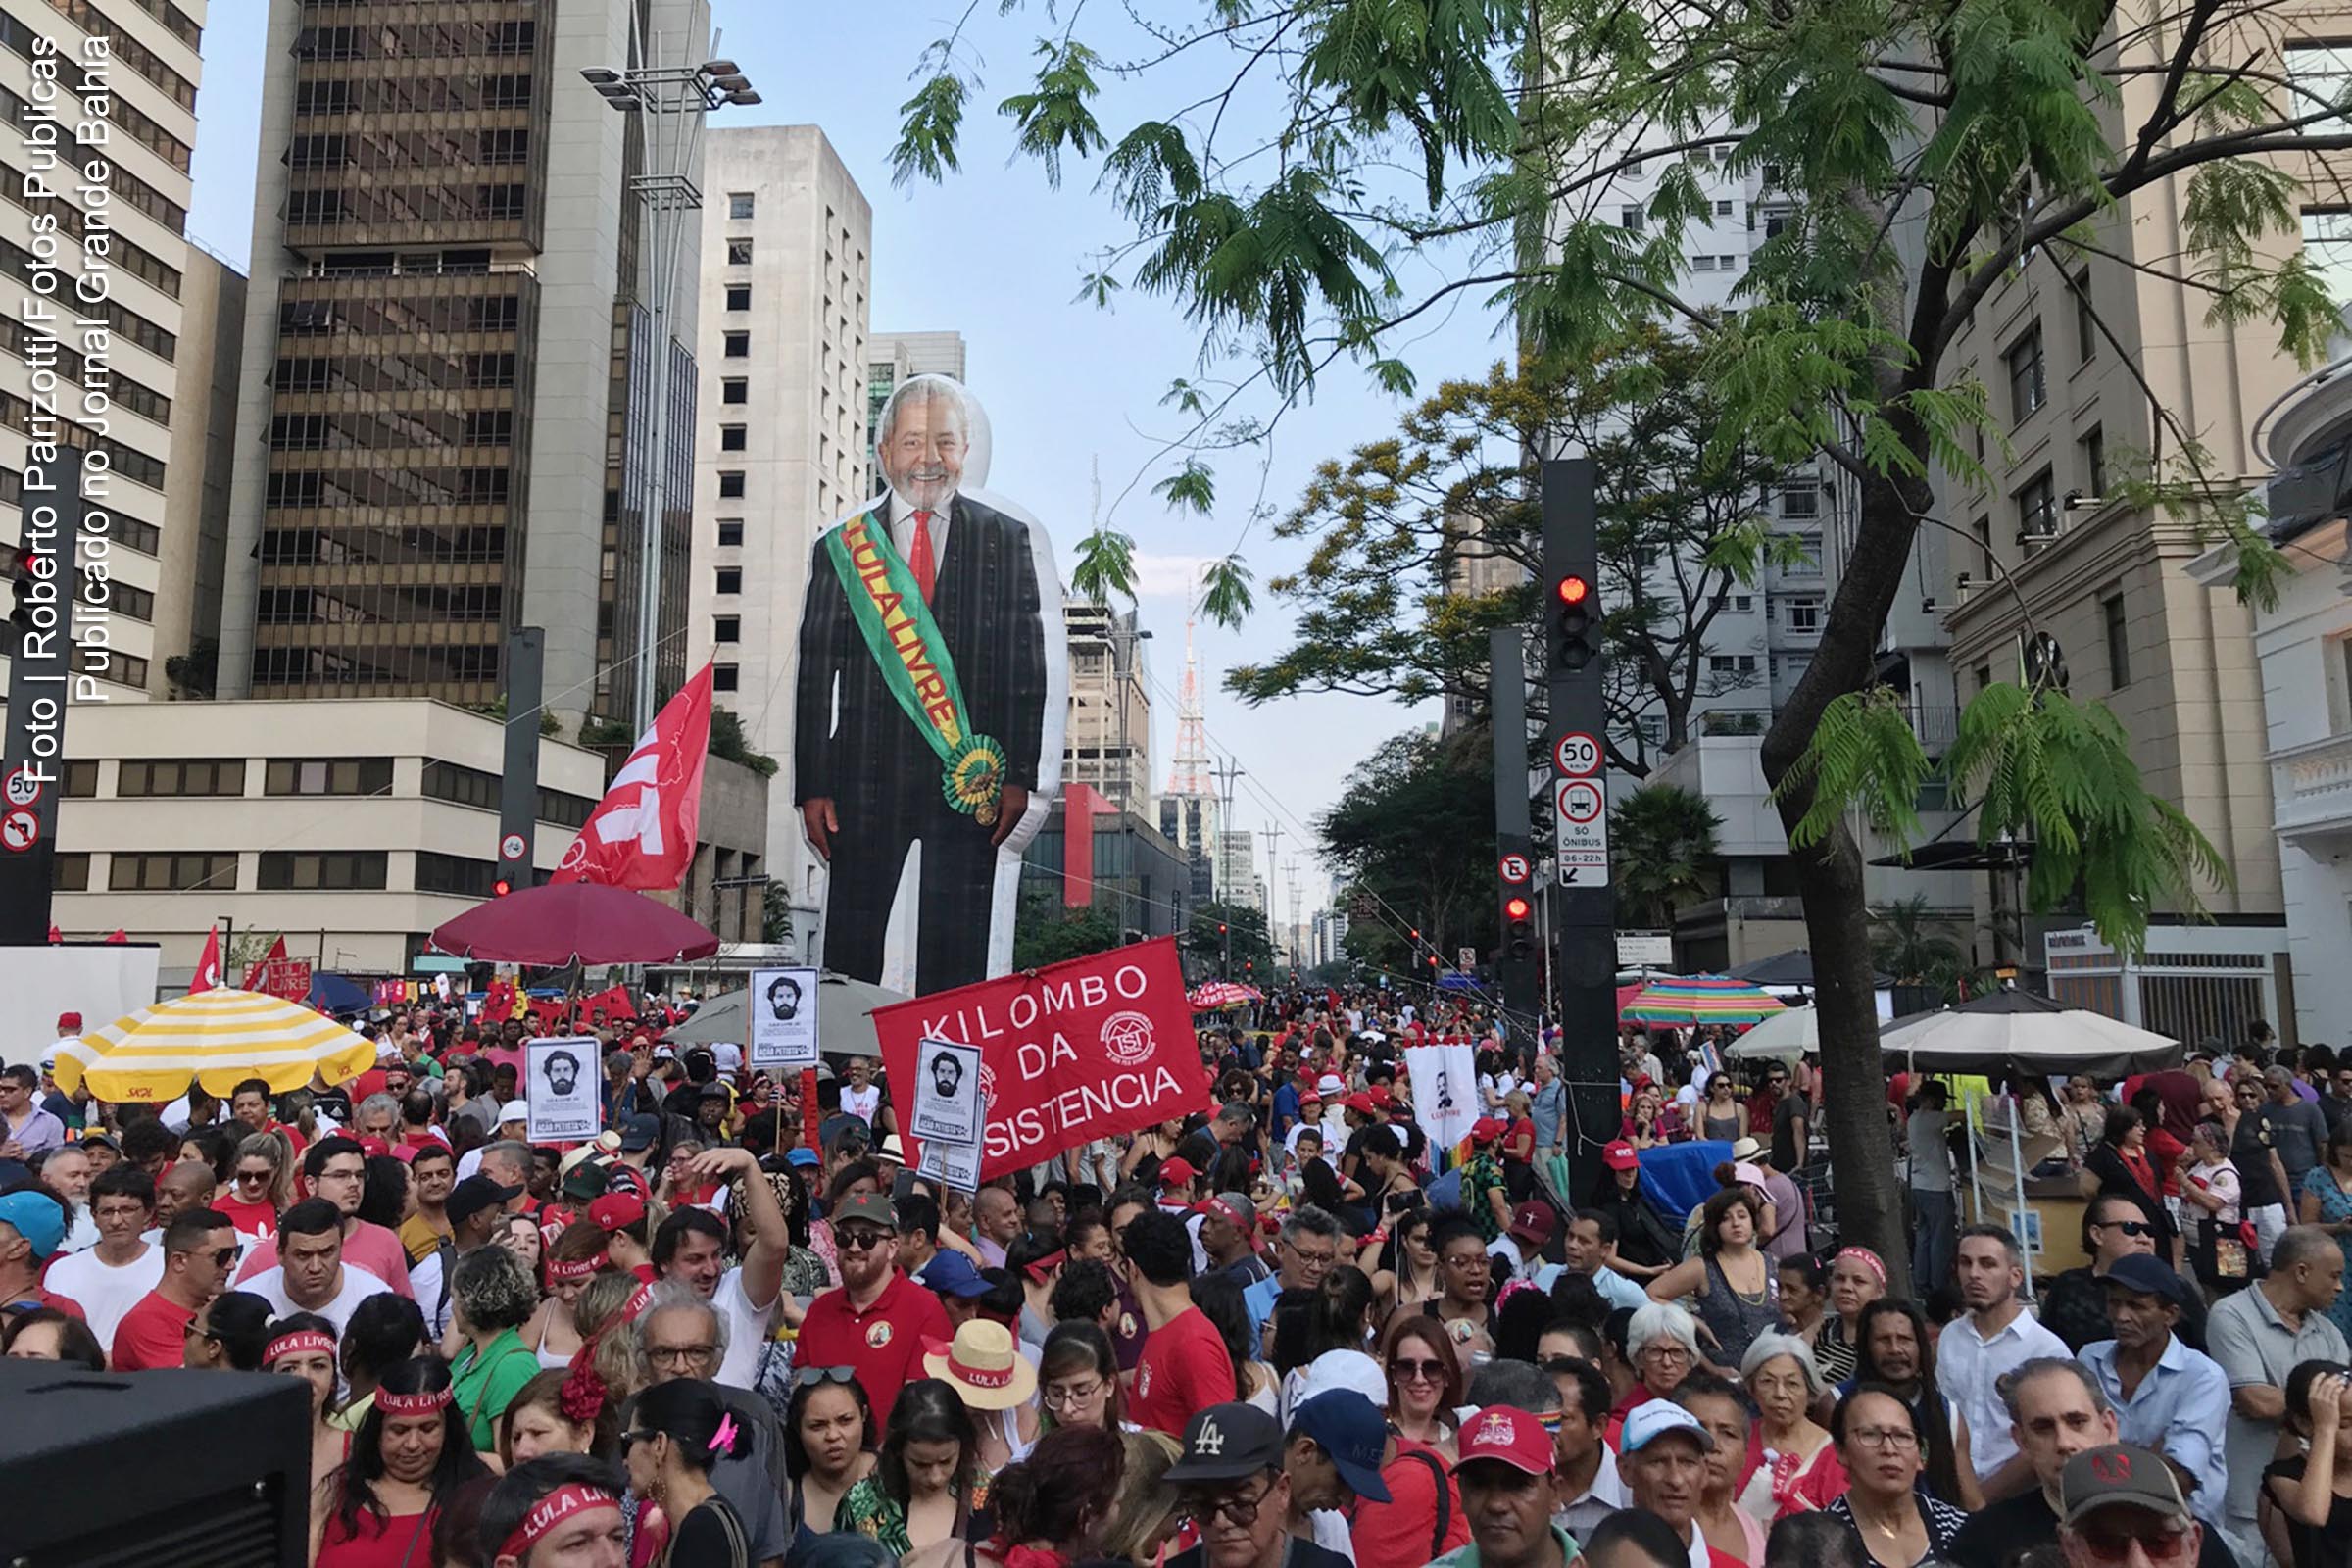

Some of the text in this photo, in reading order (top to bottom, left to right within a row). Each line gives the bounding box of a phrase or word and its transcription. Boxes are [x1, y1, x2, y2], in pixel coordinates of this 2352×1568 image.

[840, 523, 958, 728] LULA LIVRE
[1564, 744, 1593, 761] 50
[1563, 836, 1601, 847] ÔNIBUS
[922, 965, 1147, 1044] KILOMBO
[1017, 1032, 1078, 1081] DA
[983, 1065, 1183, 1157] SISTENCIA
[270, 1337, 299, 1356] LULA
[968, 1373, 999, 1386] LULA
[383, 1393, 413, 1408] LULA
[1195, 1414, 1224, 1455] LA
[523, 1493, 578, 1539] LULA
